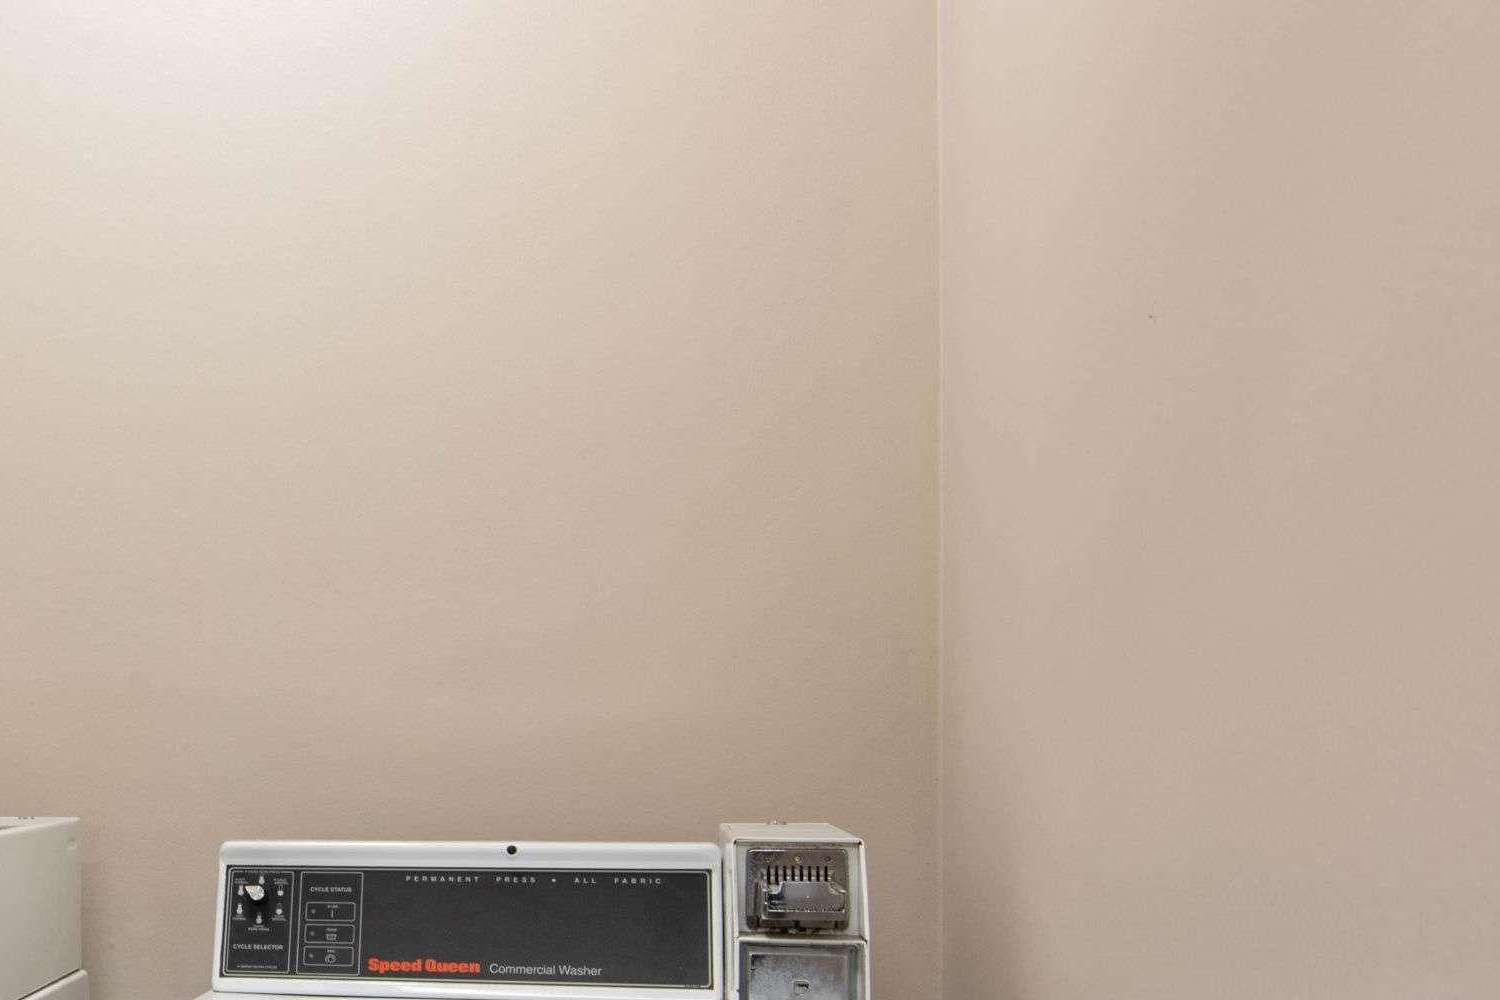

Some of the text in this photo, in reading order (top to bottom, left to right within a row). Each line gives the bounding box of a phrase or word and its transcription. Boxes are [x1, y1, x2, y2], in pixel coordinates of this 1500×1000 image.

[405, 875, 481, 883] PERMANENT
[495, 876, 537, 884] PRESS
[614, 877, 662, 885] FABRIC
[367, 958, 603, 976] Speed Queen Commercial Washer
